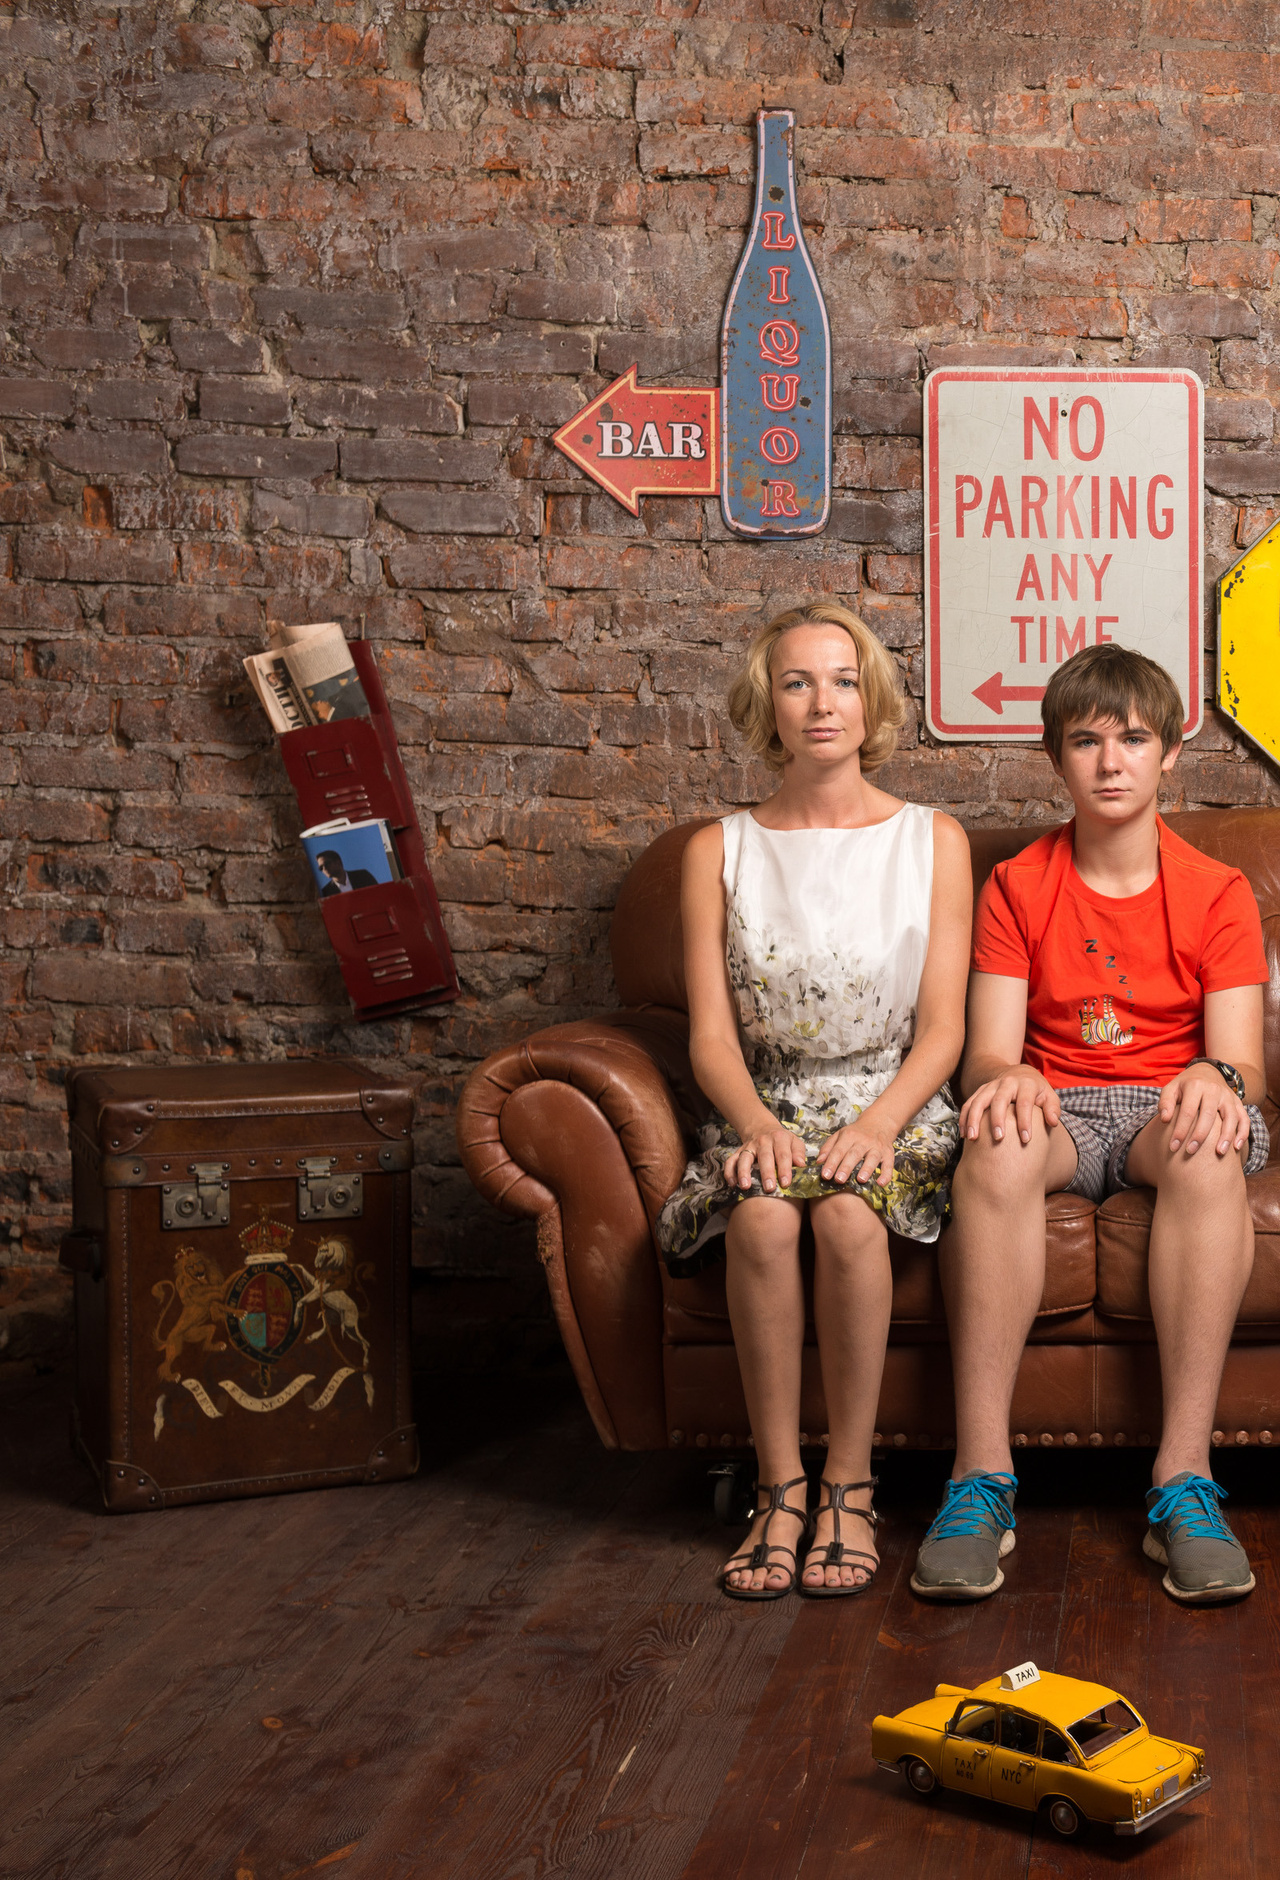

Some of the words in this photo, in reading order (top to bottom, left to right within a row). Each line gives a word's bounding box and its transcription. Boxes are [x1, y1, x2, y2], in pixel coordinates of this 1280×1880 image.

[761, 211, 801, 519] LIQUOR
[597, 421, 705, 460] BAR
[1023, 394, 1106, 462] NO
[955, 474, 1175, 540] PARKING
[1015, 552, 1113, 602] ANY
[1010, 615, 1119, 664] TIME
[1015, 1667, 1036, 1683] TAXI
[954, 1757, 977, 1771] TAXI
[1001, 1767, 1022, 1785] NYC
